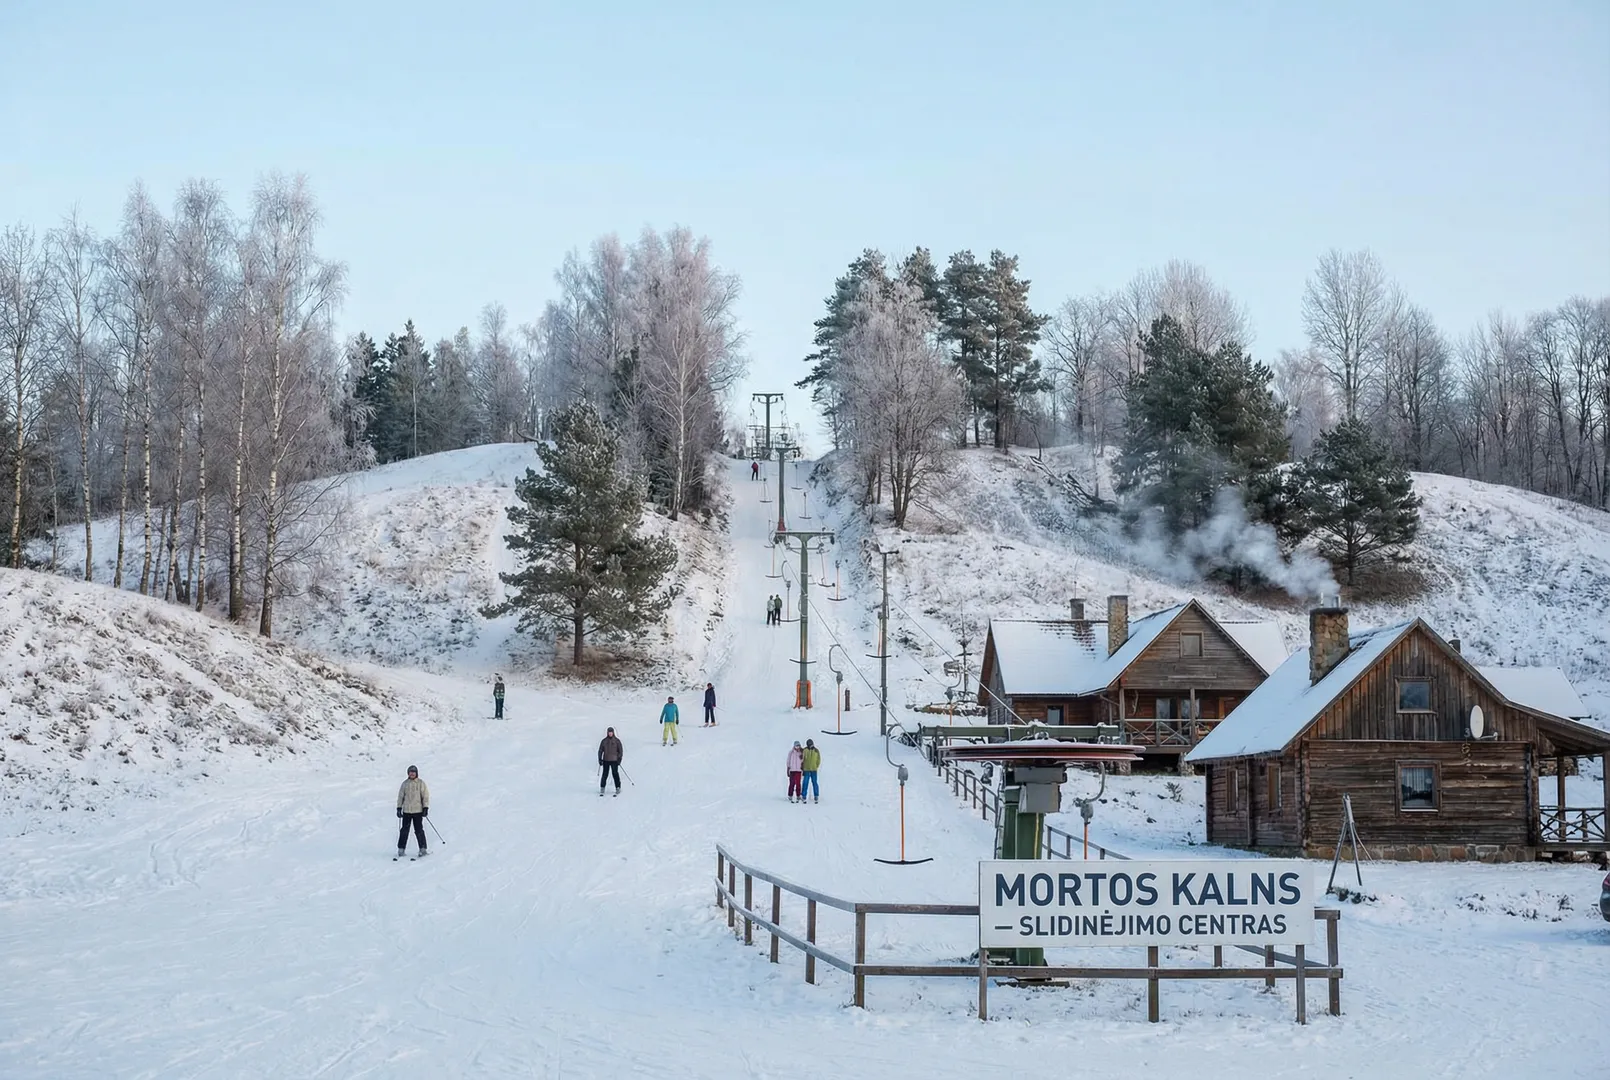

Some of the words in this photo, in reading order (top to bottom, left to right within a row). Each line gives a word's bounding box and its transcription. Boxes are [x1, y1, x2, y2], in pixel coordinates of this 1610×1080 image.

[995, 873, 1158, 906] MORTOS
[1172, 872, 1300, 906] KALNS
[1019, 909, 1171, 936] SLIDINĖJIMO
[1178, 914, 1287, 935] CENTRAS
